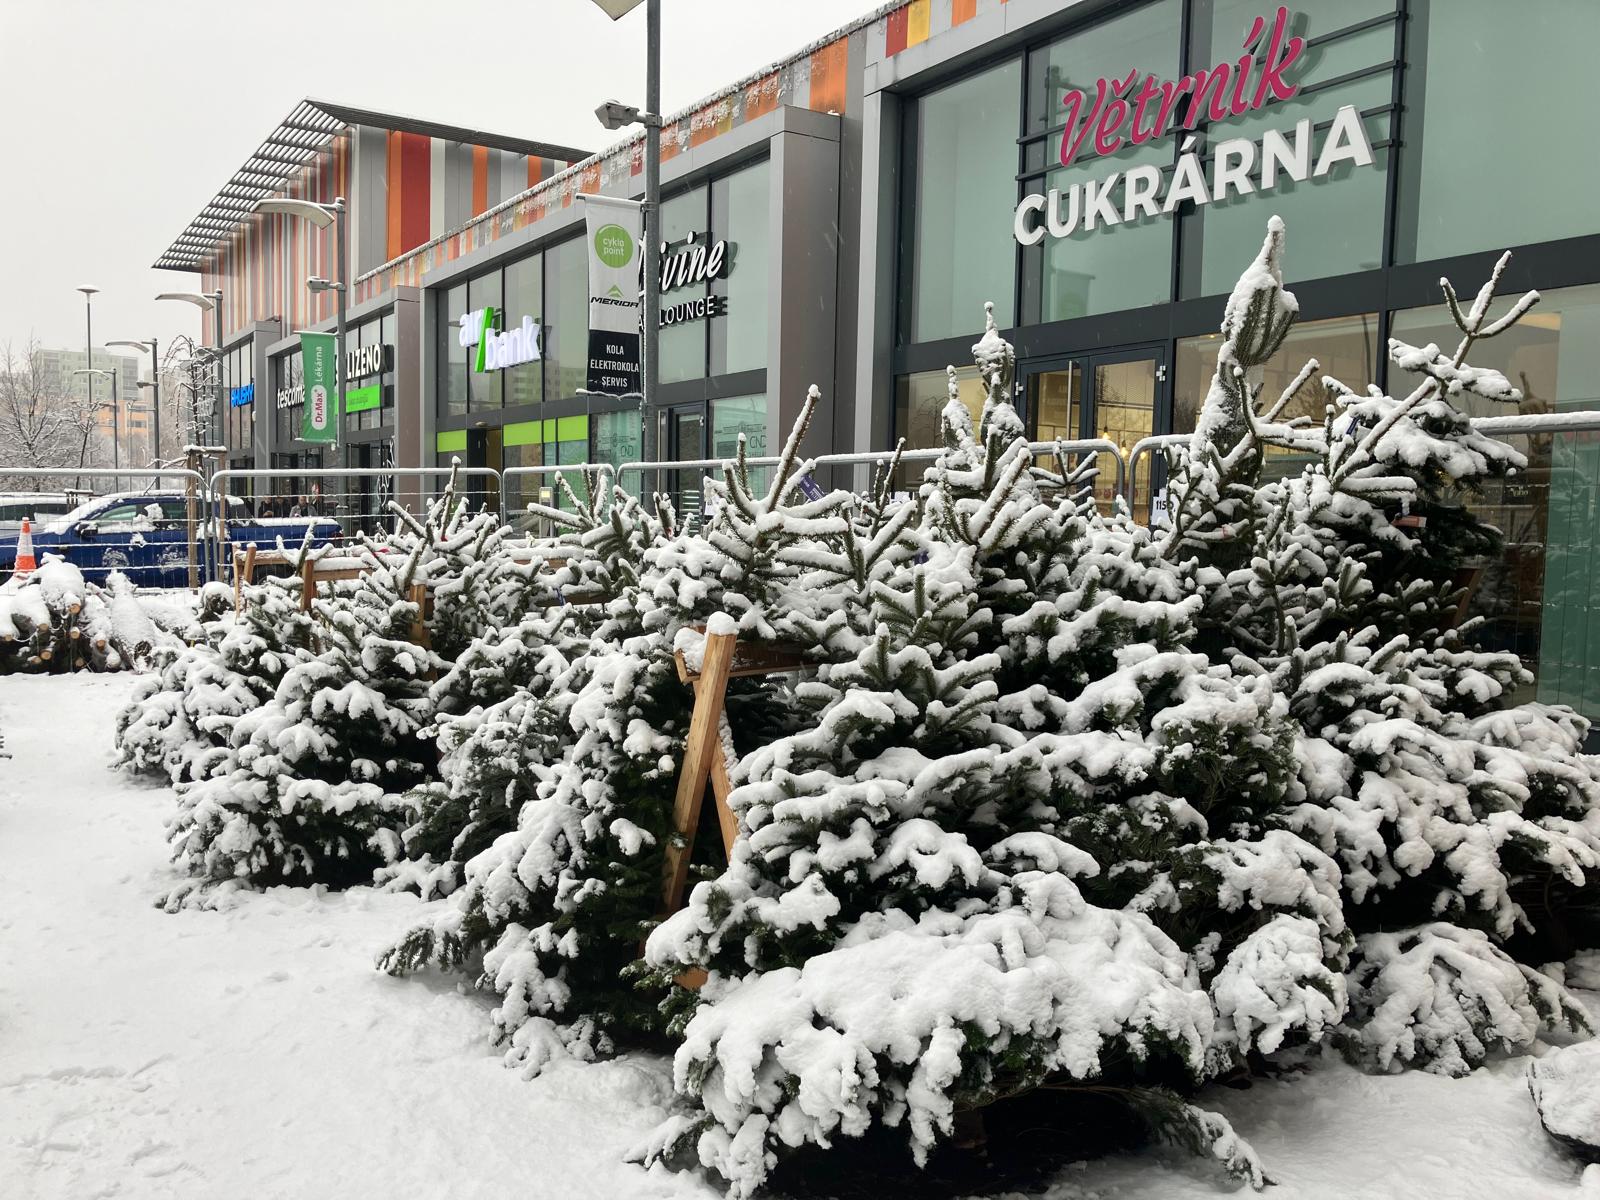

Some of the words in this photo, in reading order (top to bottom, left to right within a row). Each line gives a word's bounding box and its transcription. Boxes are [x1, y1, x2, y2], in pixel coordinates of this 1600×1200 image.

[1060, 6, 1305, 167] Větrník
[1014, 104, 1375, 246] CUKRÁRNA
[603, 247, 625, 256] point
[639, 230, 725, 295] vine
[590, 296, 639, 308] MERIDA
[659, 295, 715, 326] LOUNGE
[485, 315, 541, 370] bank
[606, 344, 624, 355] KOLA
[314, 346, 323, 382] Lékárna
[336, 343, 381, 380] LIZENO
[590, 359, 640, 372] ELEKTROKOLA
[601, 376, 628, 388] SERVIS
[315, 392, 323, 423] Dr.Max
